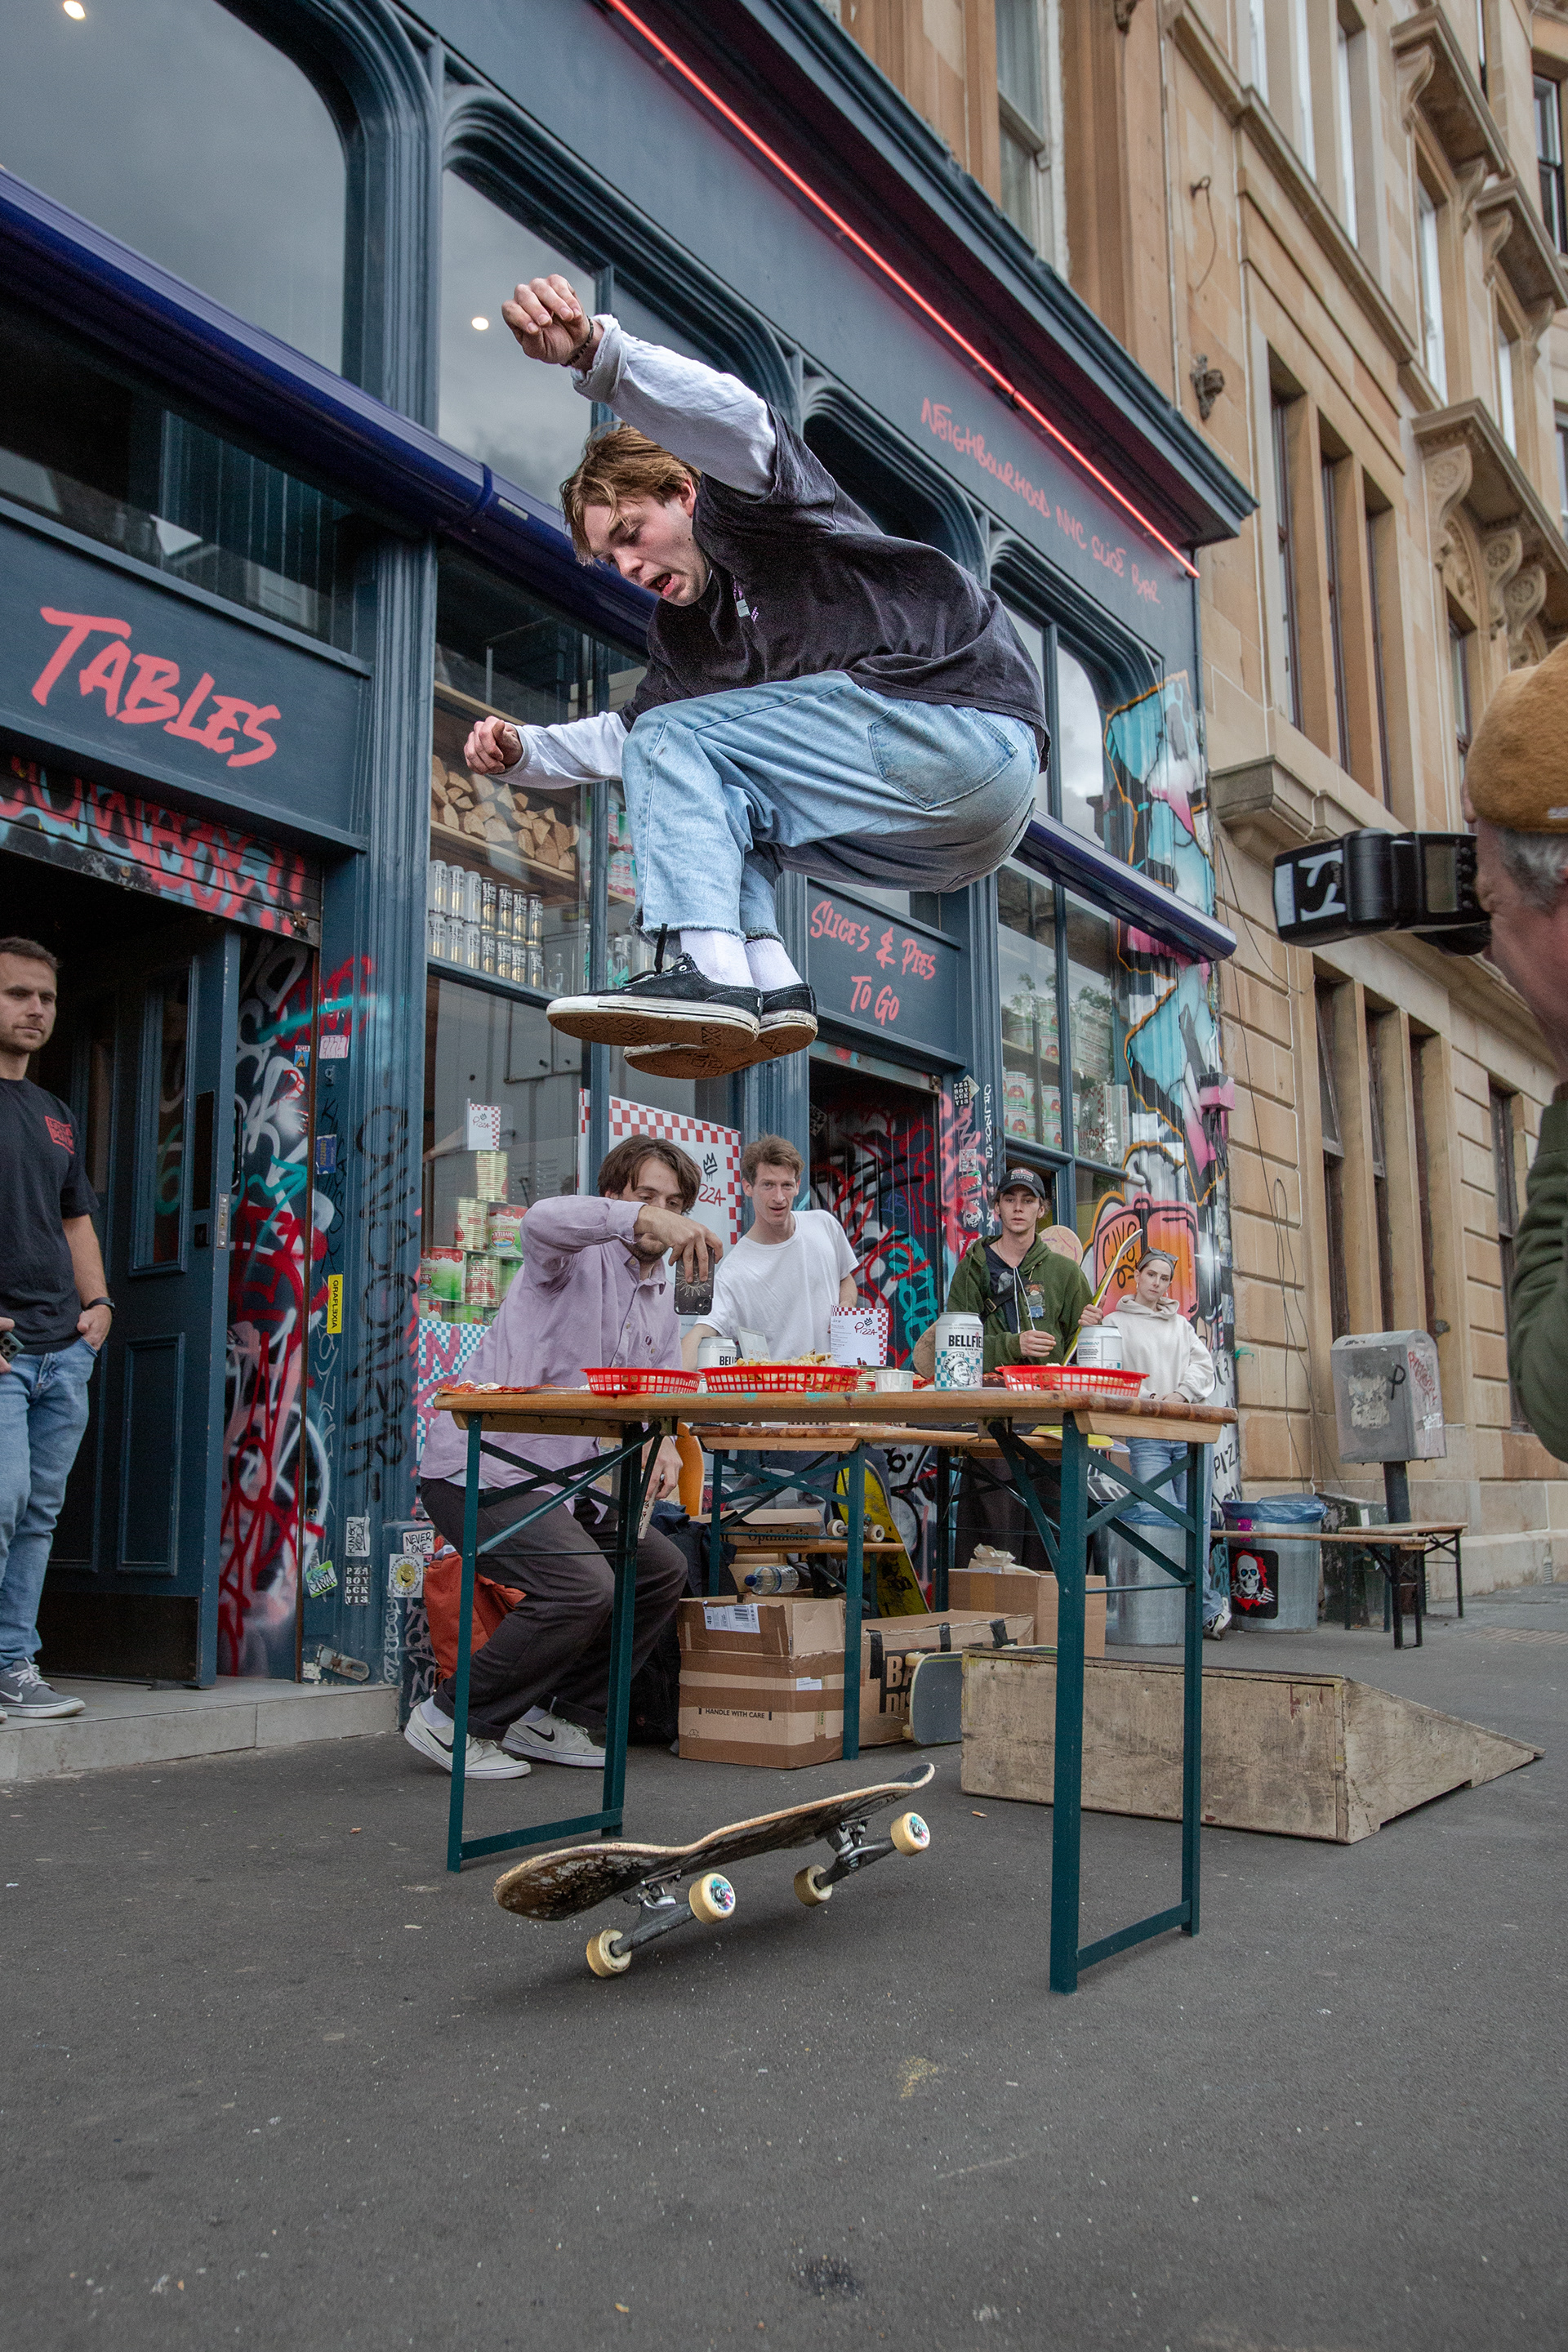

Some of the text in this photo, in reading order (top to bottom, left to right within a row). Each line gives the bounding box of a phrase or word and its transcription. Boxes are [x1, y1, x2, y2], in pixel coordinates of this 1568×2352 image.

[921, 397, 1051, 518] NEIGHBOURHOOD
[31, 607, 281, 768] TABLES
[810, 900, 937, 980] SLICES & PIES
[850, 975, 899, 1026] TO GO
[698, 1183, 726, 1207] ZZA
[854, 1321, 878, 1335] PIZZA
[405, 1532, 432, 1546] NEVER
[345, 1576, 368, 1584] BOY
[705, 1708, 730, 1716] HANDLE
